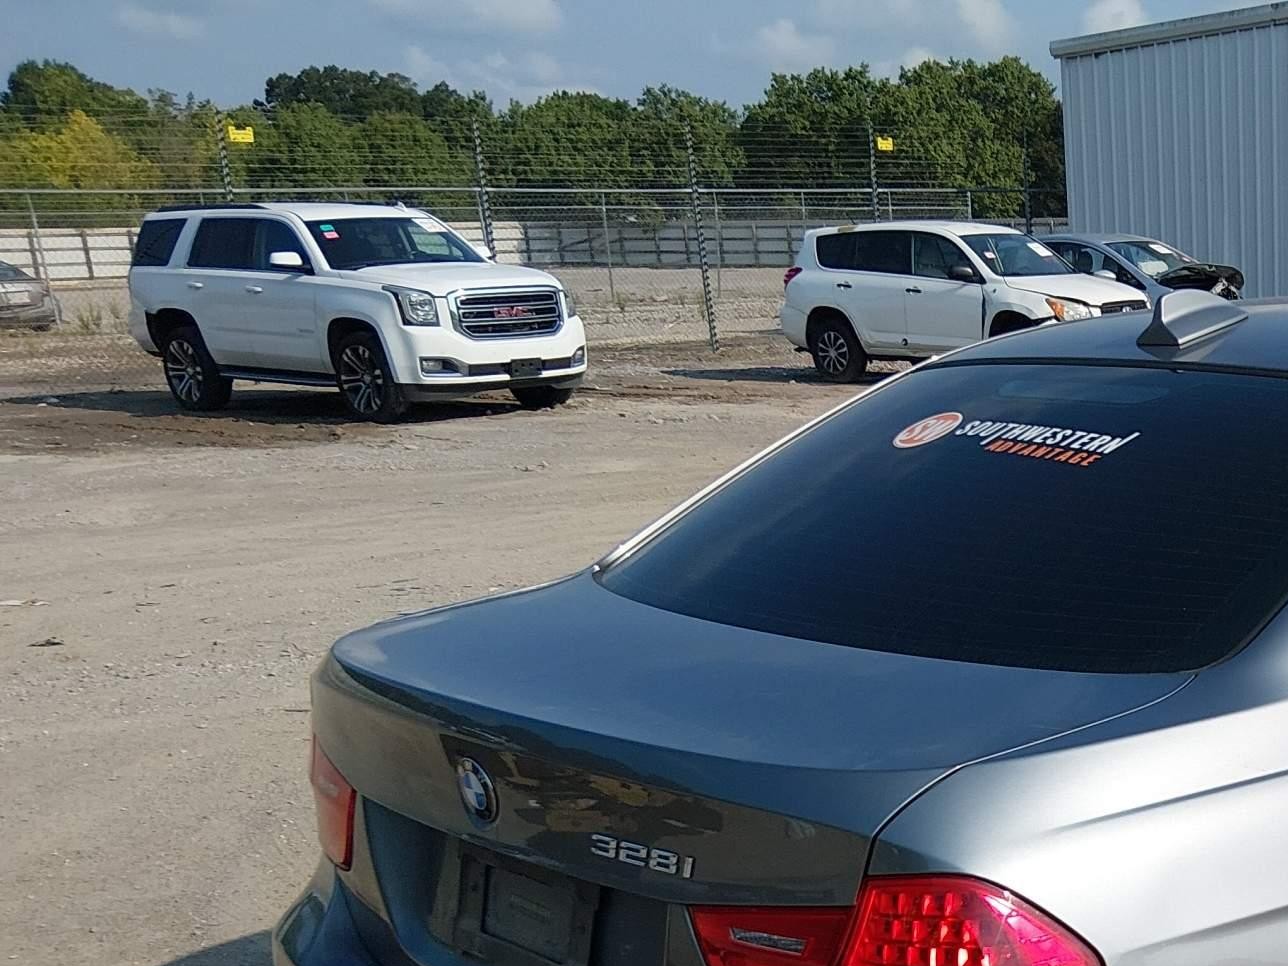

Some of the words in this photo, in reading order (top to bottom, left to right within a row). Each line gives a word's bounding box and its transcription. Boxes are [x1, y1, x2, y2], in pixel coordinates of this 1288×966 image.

[899, 417, 957, 442] SW
[955, 420, 1140, 454] SOUTHWESTERN
[985, 441, 1101, 466] ADVANTAGE
